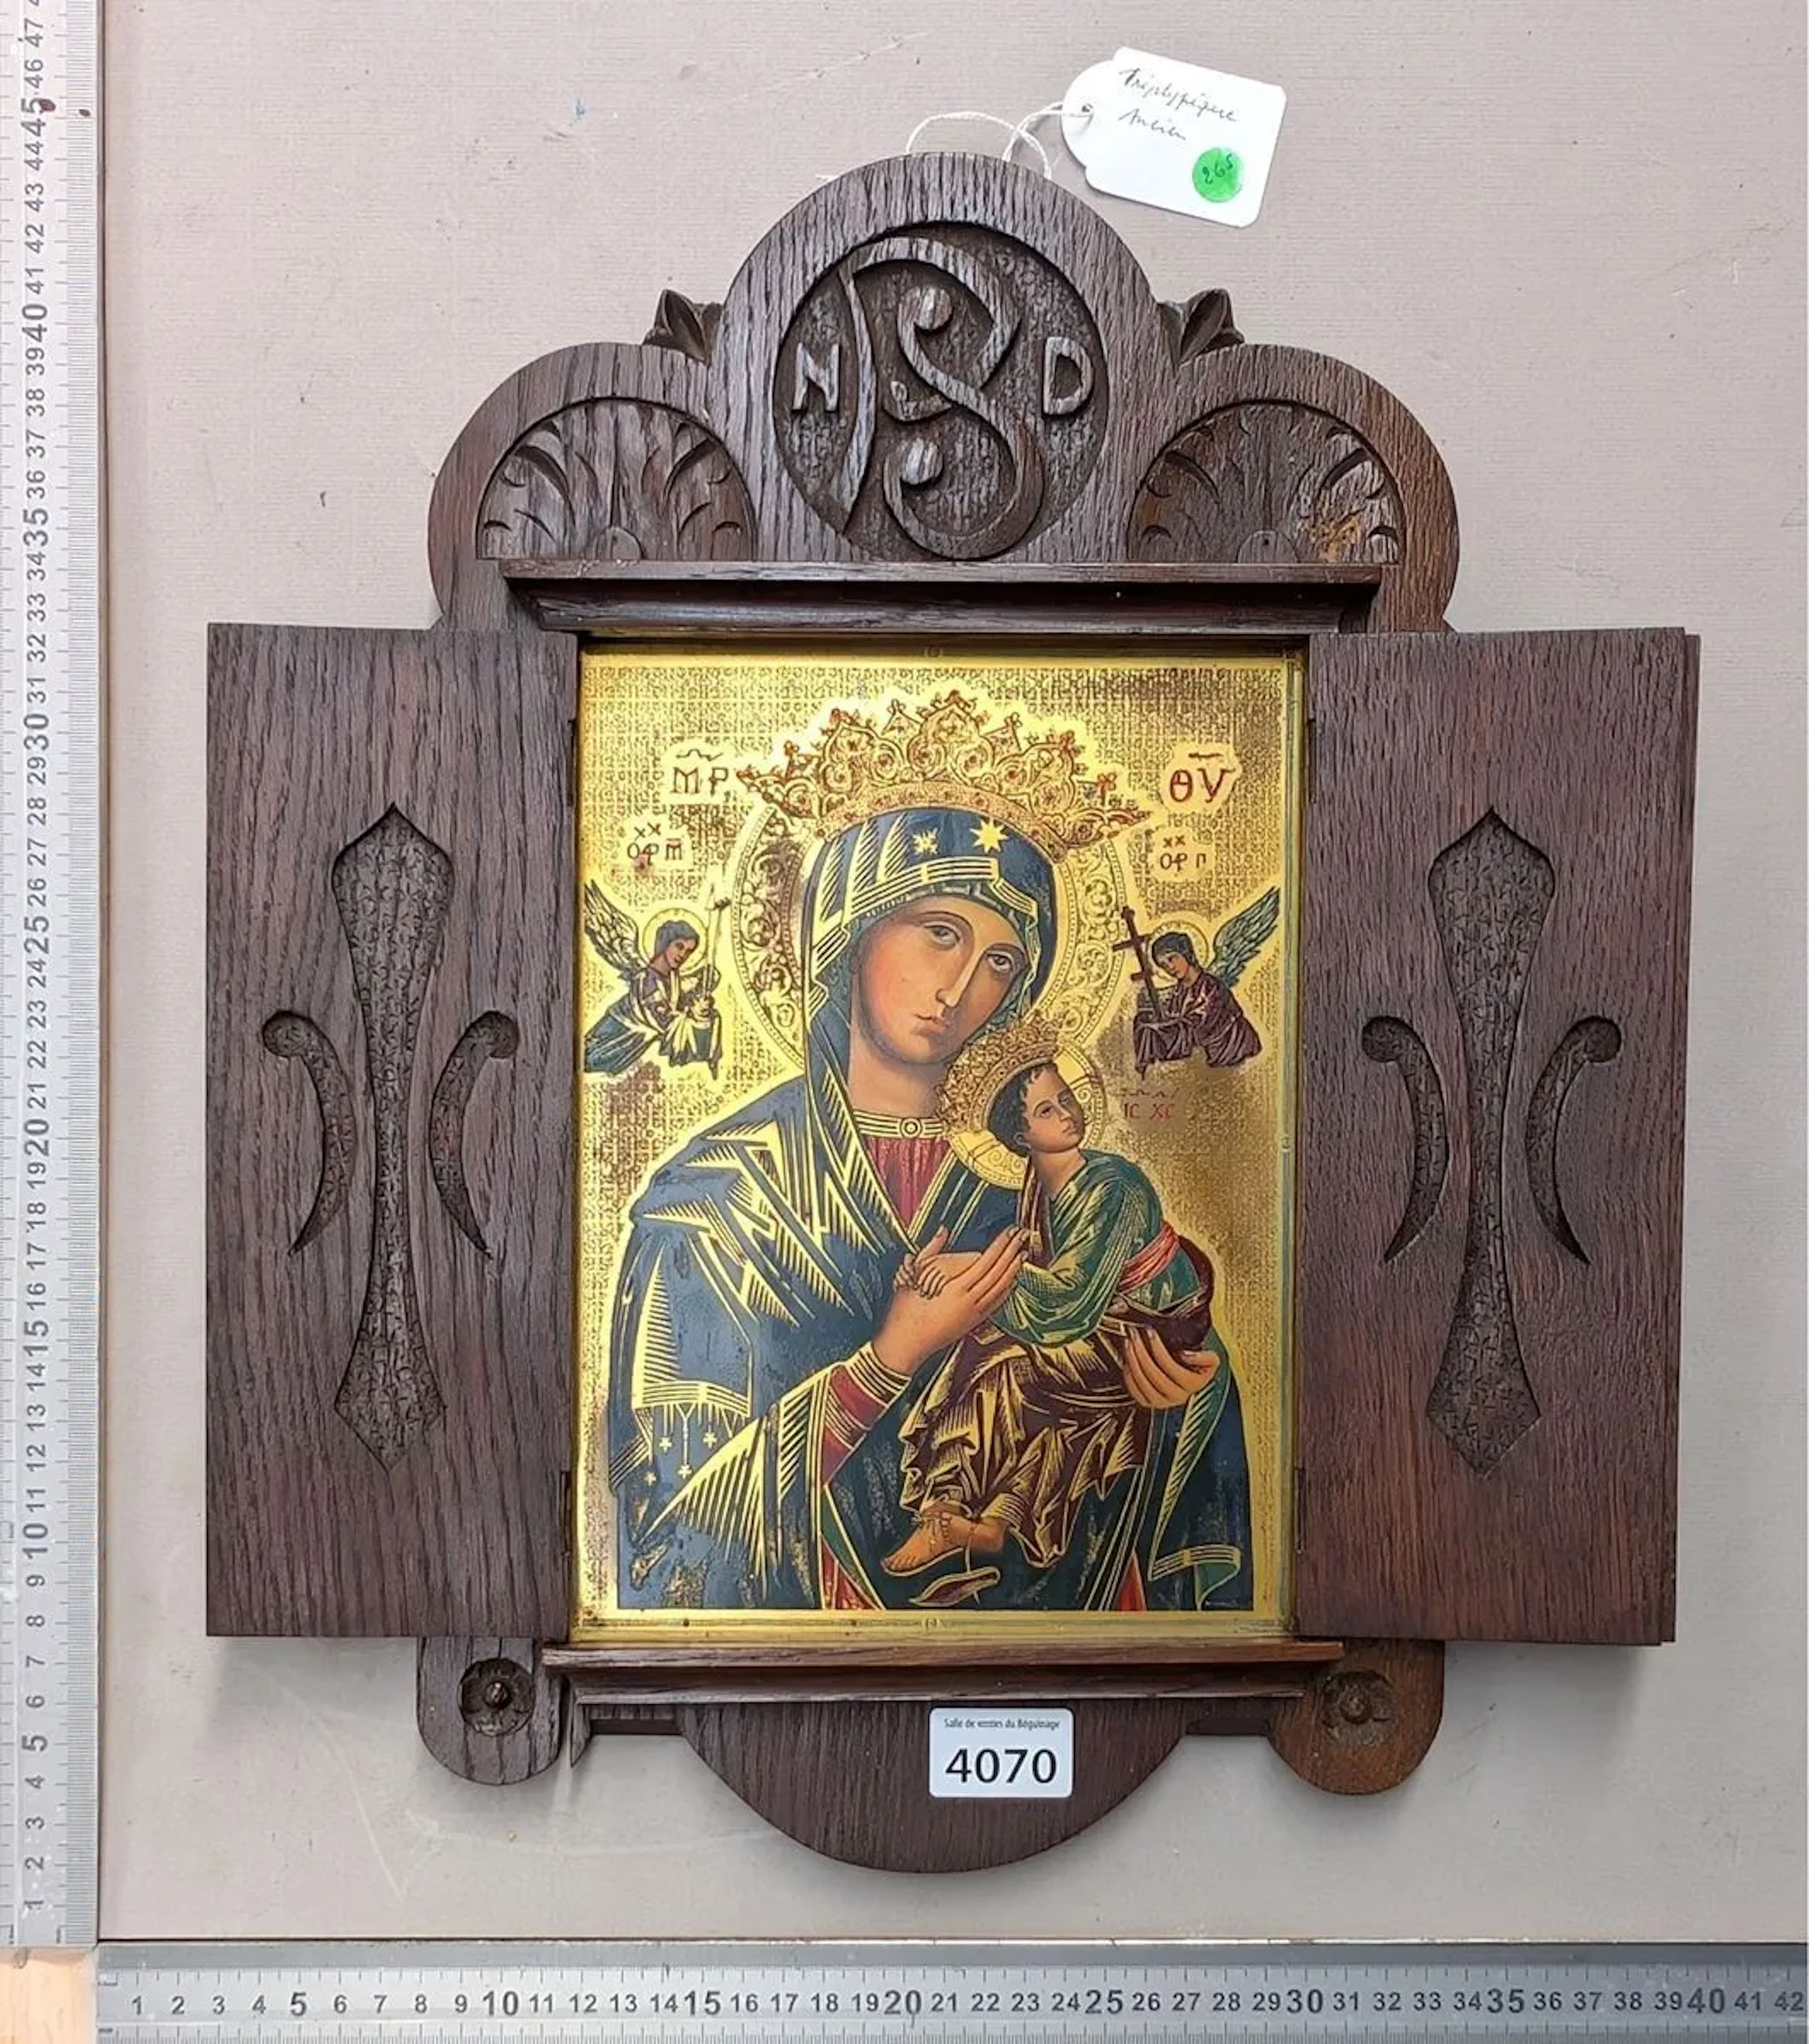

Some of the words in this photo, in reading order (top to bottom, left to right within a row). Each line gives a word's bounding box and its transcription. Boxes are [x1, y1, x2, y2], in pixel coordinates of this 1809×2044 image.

[24, 17, 43, 48] 47
[24, 59, 44, 89] 46
[24, 141, 44, 171] 44
[24, 183, 44, 213] 43
[24, 224, 44, 254] 42
[24, 268, 44, 295] 41
[21, 303, 48, 343] 40
[25, 347, 45, 376] 39
[793, 343, 840, 413] N
[1043, 336, 1094, 416] D
[25, 388, 45, 417] 38
[25, 428, 46, 459] 37
[25, 470, 46, 499] 36
[22, 508, 49, 547] 35
[26, 551, 46, 581] 34
[26, 593, 46, 622] 33
[26, 634, 46, 663] 32
[26, 677, 46, 704] 31
[23, 713, 49, 751] 30
[26, 756, 47, 786] 29
[26, 797, 47, 826] 28
[27, 837, 47, 866] 27
[27, 878, 47, 907] 26
[23, 916, 49, 954] 25
[26, 958, 47, 988] 24
[26, 1000, 47, 1029] 23
[26, 1040, 47, 1069] 22
[26, 1083, 47, 1109] 21
[23, 1119, 49, 1157] 20
[26, 1162, 47, 1189] 19
[26, 1202, 47, 1230] 18
[26, 1242, 46, 1270] 17
[26, 1282, 46, 1311] 16
[22, 1320, 49, 1357] 15
[26, 1363, 46, 1392] 14
[26, 1404, 46, 1432] 13
[26, 1444, 46, 1472] 12
[25, 1489, 46, 1513] 11
[22, 1523, 49, 1559] 10
[25, 1574, 45, 1588] 9
[25, 1614, 45, 1628] 8
[25, 1655, 45, 1668] 7
[25, 1695, 45, 1709] 6
[21, 1735, 48, 1752] 5
[945, 1748, 1057, 1783] 4070
[24, 1775, 45, 1789] 4
[24, 1816, 45, 1830] 3
[24, 1857, 44, 1870] 2
[24, 1900, 44, 1910] 1
[132, 1995, 141, 2015] 1
[171, 1995, 185, 2015] 2
[212, 1995, 225, 2015] 3
[252, 1995, 267, 2014] 4
[290, 1991, 307, 2018] 5
[334, 1994, 347, 2015] 6
[374, 1995, 387, 2014] 7
[414, 1994, 428, 2014] 8
[454, 1994, 468, 2014] 9
[482, 1990, 519, 2018] 10
[529, 1993, 553, 2014] 11
[569, 1993, 598, 2015] 12
[610, 1993, 638, 2014] 13
[650, 1993, 679, 2013] 14
[684, 1990, 721, 2017] 15
[730, 1993, 758, 2014] 16
[770, 1993, 799, 2013] 17
[811, 1992, 839, 2014] 18
[851, 1993, 879, 2013] 19
[883, 1989, 922, 2016] 20
[930, 1992, 957, 2013] 21
[970, 1993, 1000, 2012] 22
[1011, 1992, 1040, 2012] 23
[1051, 1992, 1081, 2012] 24
[1084, 1989, 1124, 2015] 25
[1132, 1992, 1161, 2012] 26
[1172, 1992, 1201, 2012] 27
[1212, 1992, 1241, 2012] 28
[1252, 1992, 1281, 2012] 29
[1286, 1988, 1324, 2014] 30
[1333, 1991, 1359, 2011] 31
[1373, 1992, 1402, 2011] 32
[1413, 1991, 1442, 2011] 33
[1453, 1991, 1482, 2011] 34
[1487, 1988, 1525, 2014] 35
[1533, 1991, 1562, 2011] 36
[1573, 1991, 1602, 2011] 37
[1614, 1991, 1643, 2011] 38
[1654, 1991, 1682, 2011] 39
[1687, 1987, 1725, 2014] 40
[1734, 1991, 1760, 2011] 41
[1774, 1991, 1805, 2012] 42
